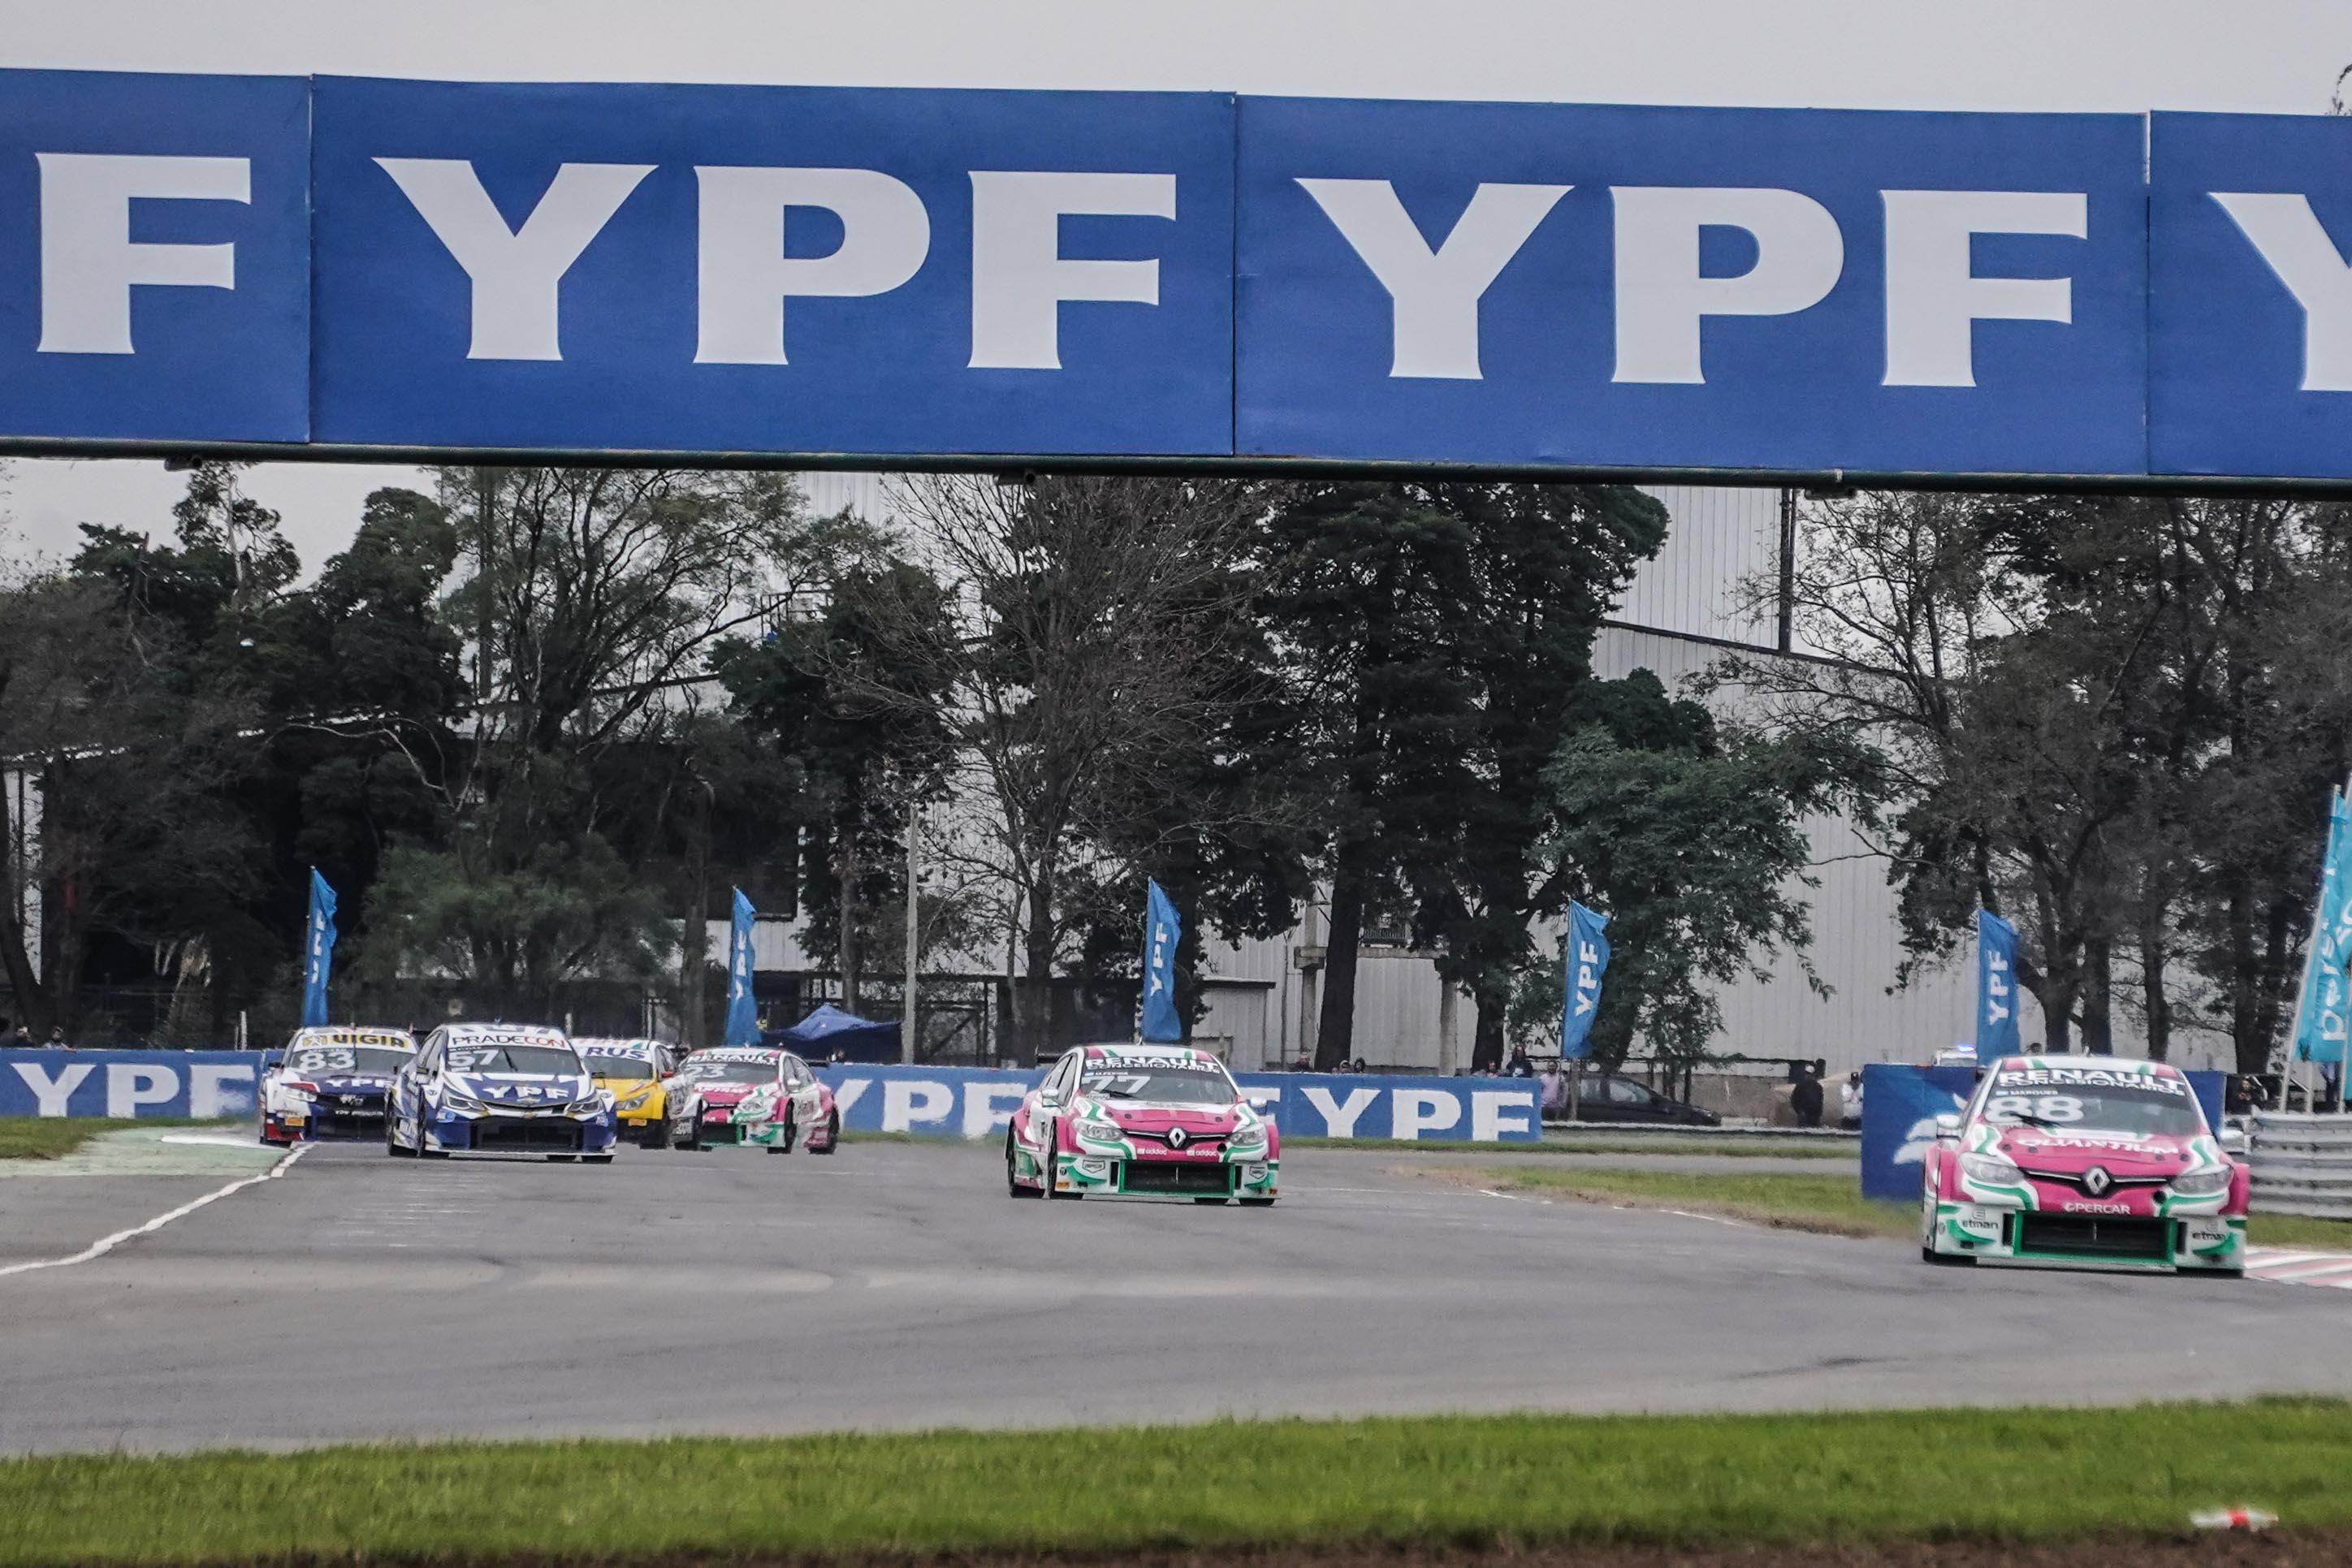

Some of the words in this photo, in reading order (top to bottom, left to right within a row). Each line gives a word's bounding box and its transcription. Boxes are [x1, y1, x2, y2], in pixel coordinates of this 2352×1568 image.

[371, 156, 1177, 369] YPF
[1293, 176, 2088, 388] YPF
[1575, 940, 1598, 1017] YPF
[1987, 949, 2009, 1026] YPF
[452, 1035, 566, 1048] PRADECON
[300, 1050, 356, 1071] 83
[447, 1049, 499, 1067] 57
[586, 1046, 646, 1059] RUS
[1084, 1057, 1220, 1070] RENAULT
[11, 1062, 255, 1119] YPF
[1082, 1076, 1152, 1094] 77
[1999, 1069, 2186, 1091] RENAULT
[2001, 1078, 2186, 1096] CONCESIONARIOS
[482, 1086, 569, 1099] YPF
[1300, 1087, 1534, 1142] YPF
[1984, 1096, 2086, 1124] 88
